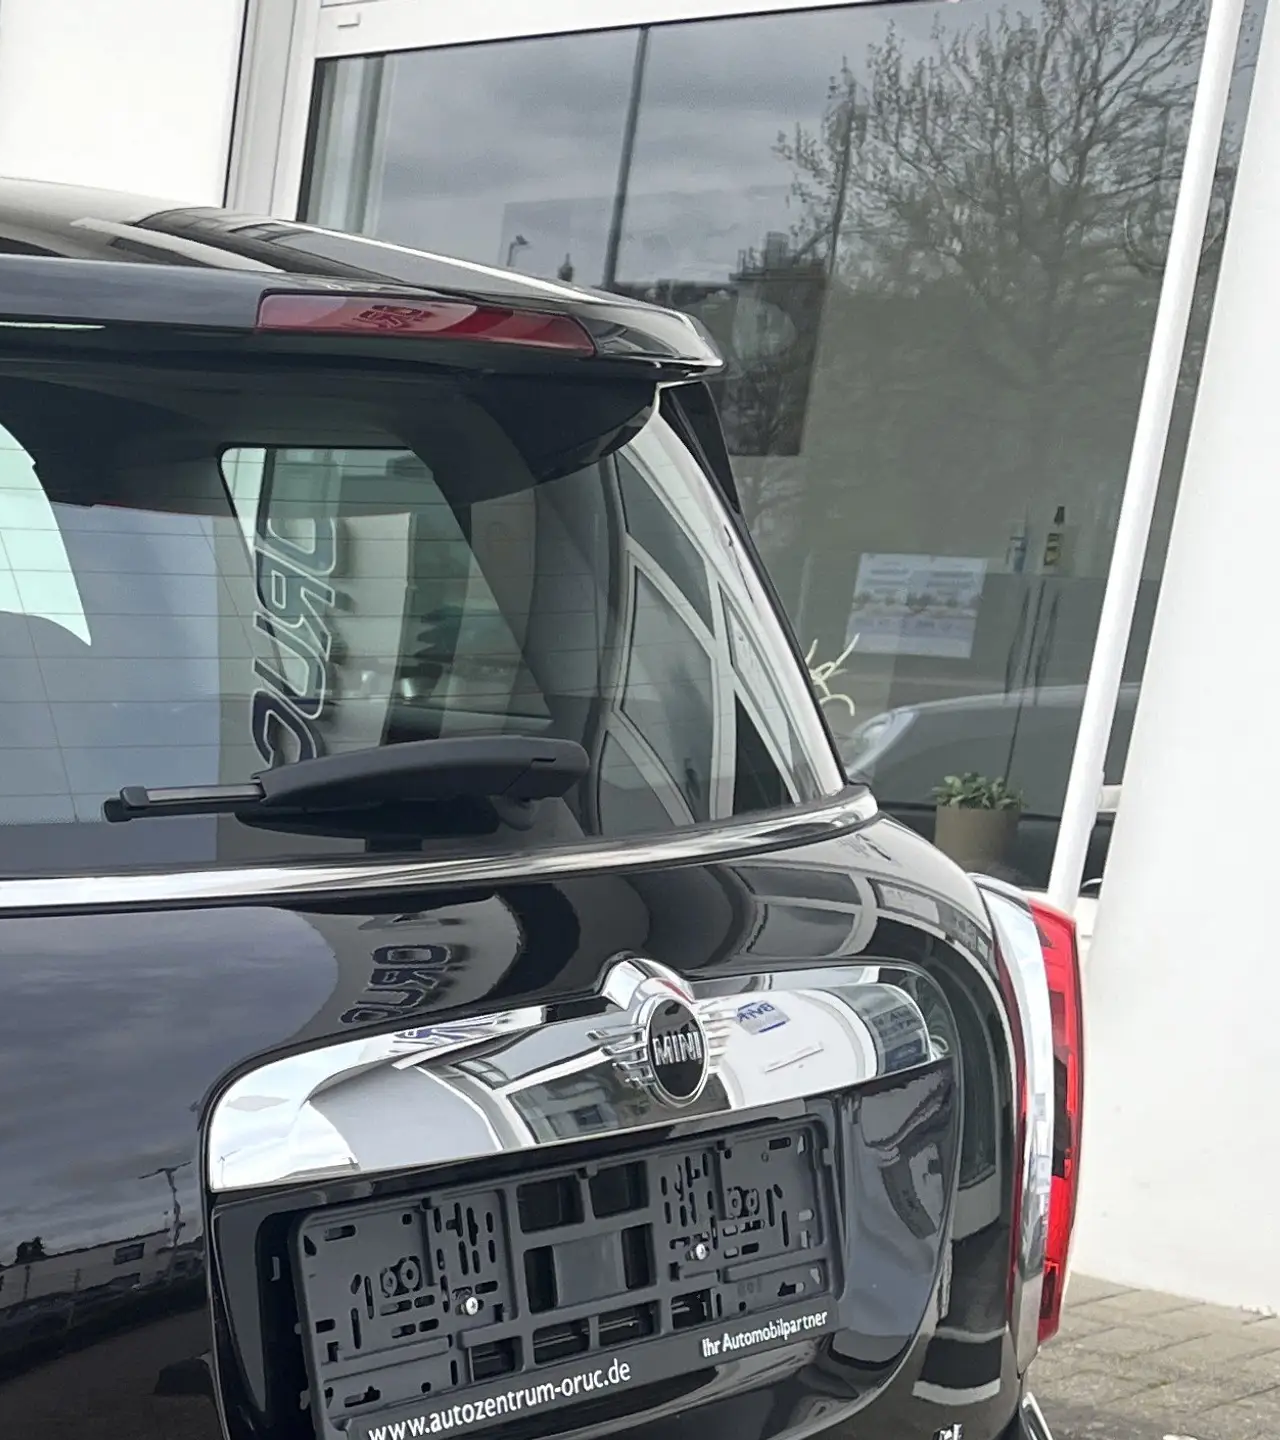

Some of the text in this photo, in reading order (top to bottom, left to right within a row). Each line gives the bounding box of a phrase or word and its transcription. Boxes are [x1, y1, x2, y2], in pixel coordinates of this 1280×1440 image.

[651, 1031, 703, 1066] MINI
[701, 1311, 828, 1358] Ihr Automobilpartner
